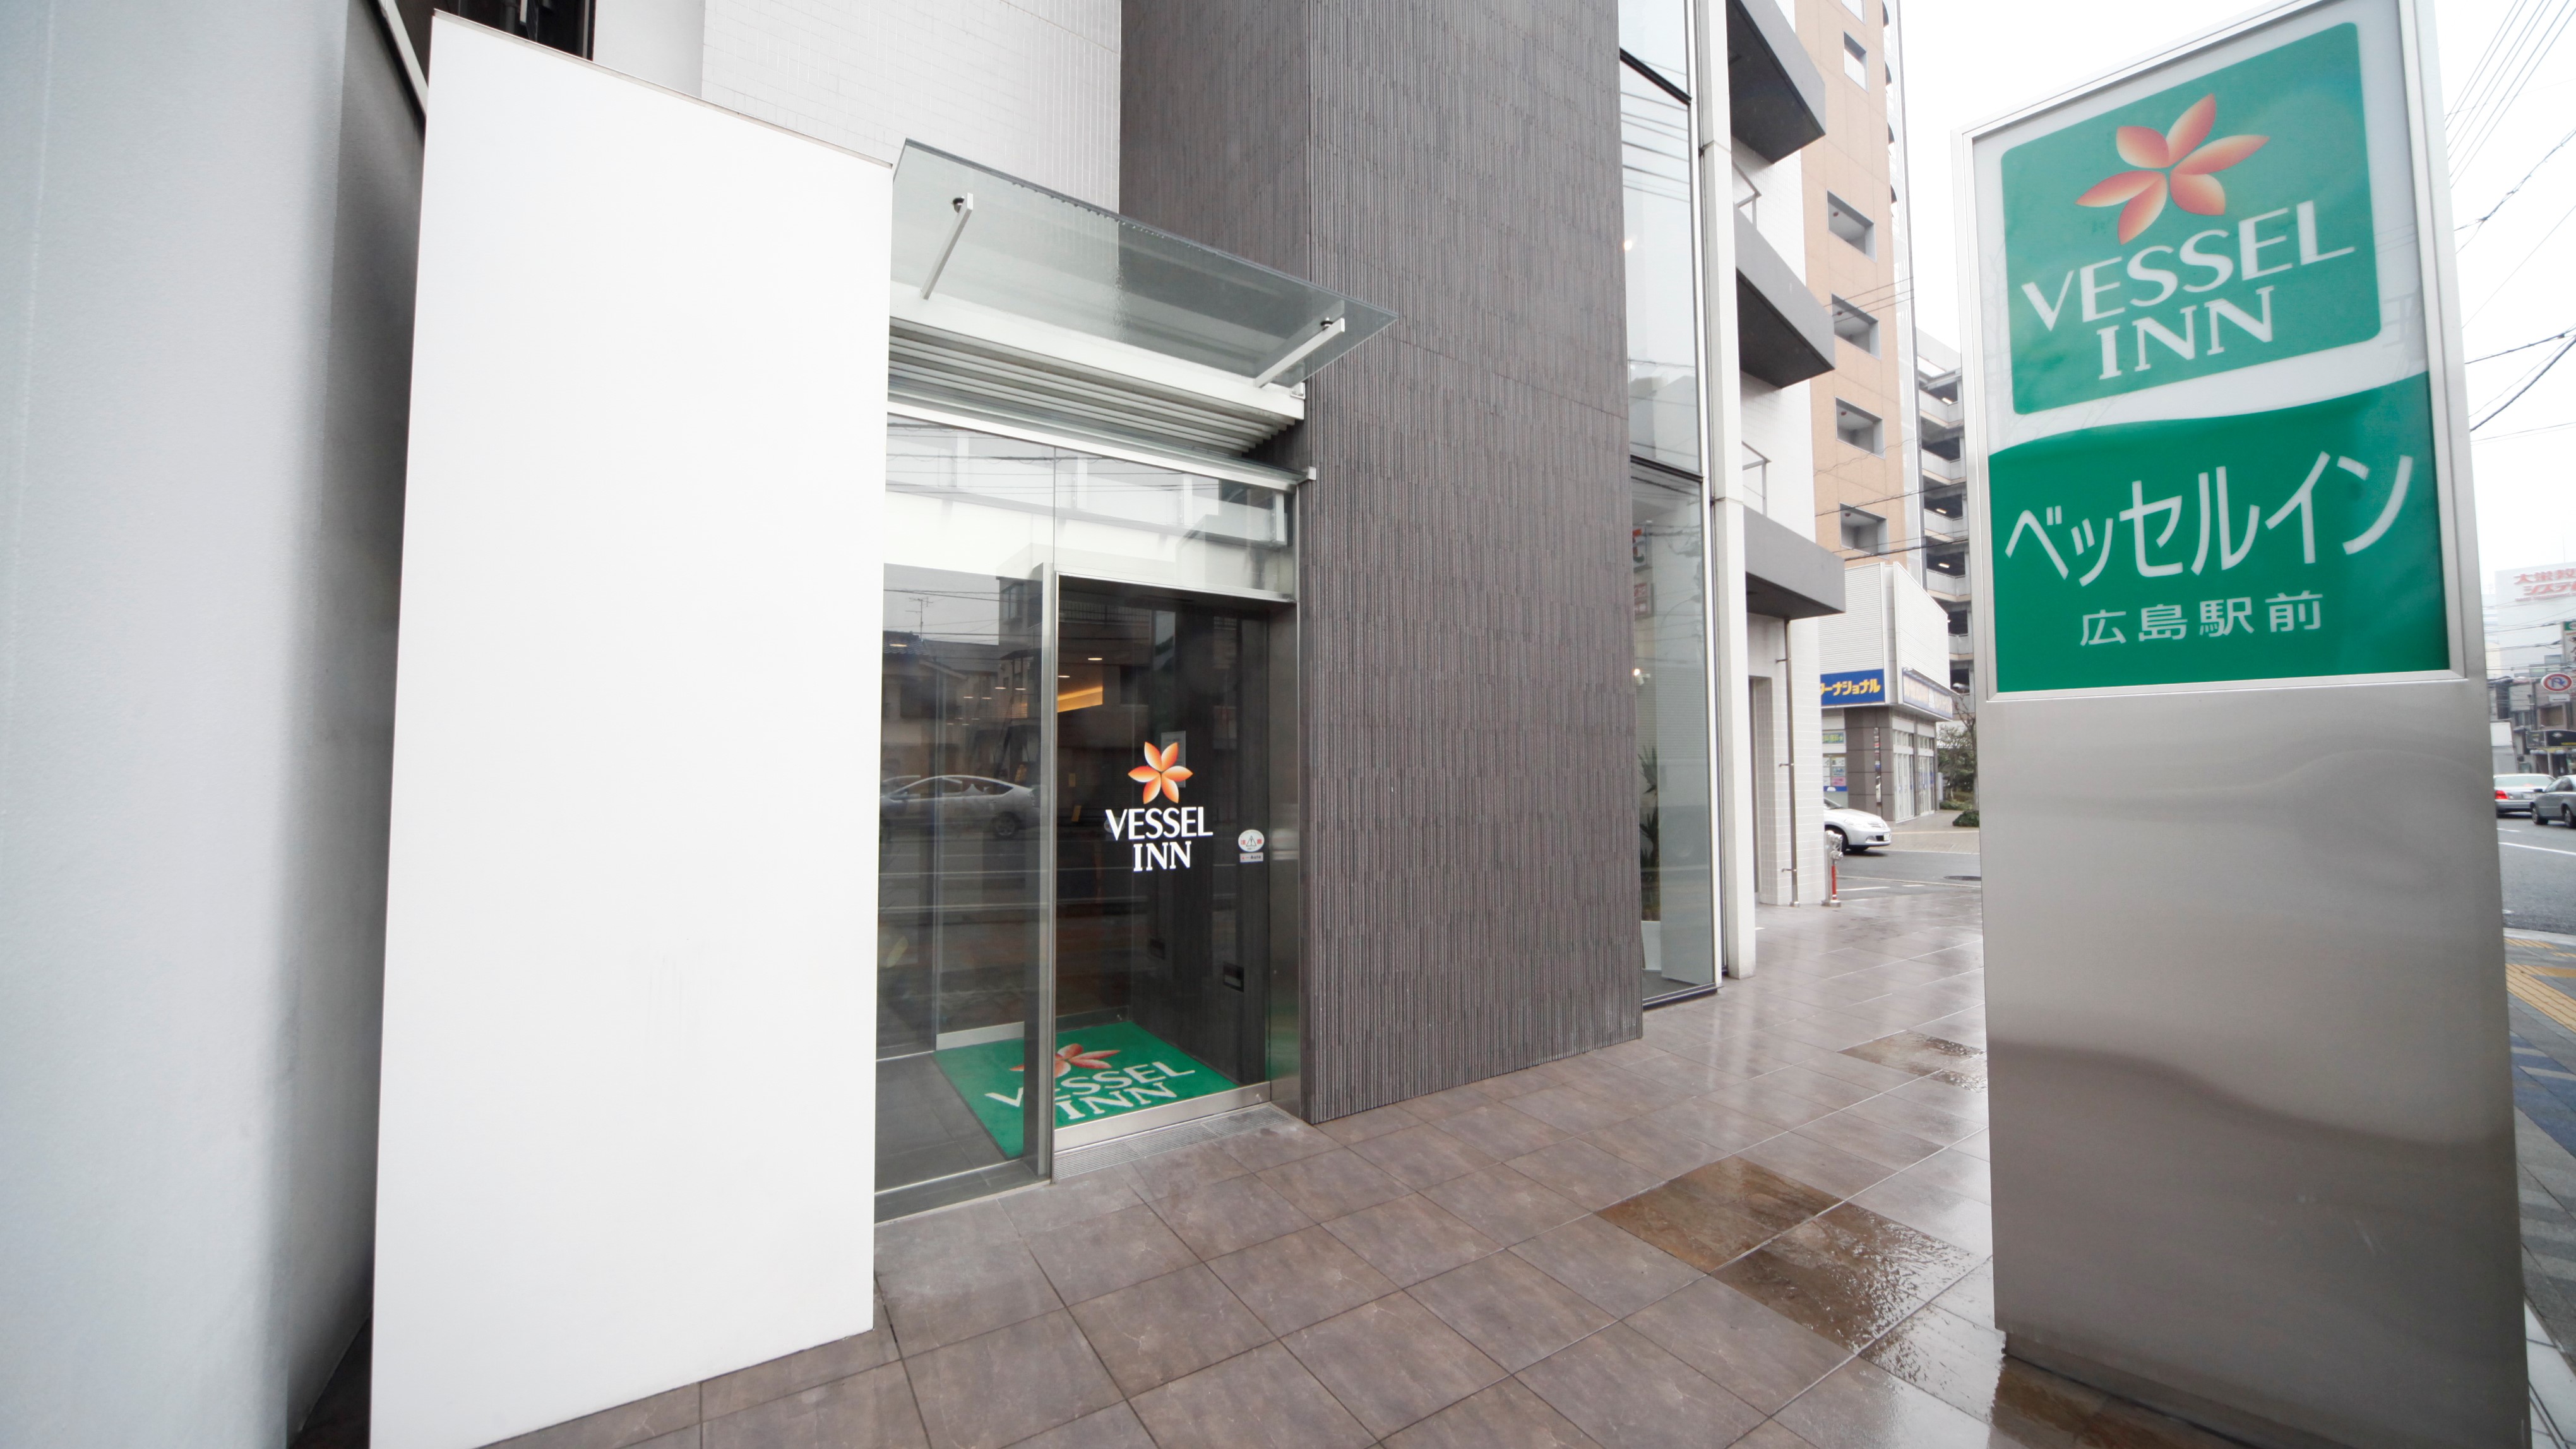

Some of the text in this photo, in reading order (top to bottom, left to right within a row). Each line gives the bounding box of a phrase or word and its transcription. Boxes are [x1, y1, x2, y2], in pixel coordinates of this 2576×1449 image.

[2021, 200, 2356, 332] VESSEL
[2096, 286, 2274, 381] INN
[2005, 451, 2414, 587] ベッセルイン
[2079, 590, 2325, 647] 広島駅前
[1105, 806, 1213, 841] VESSEL
[1133, 840, 1192, 872] INN
[984, 1061, 1195, 1107] VSSEL
[1055, 1082, 1178, 1120] INN
